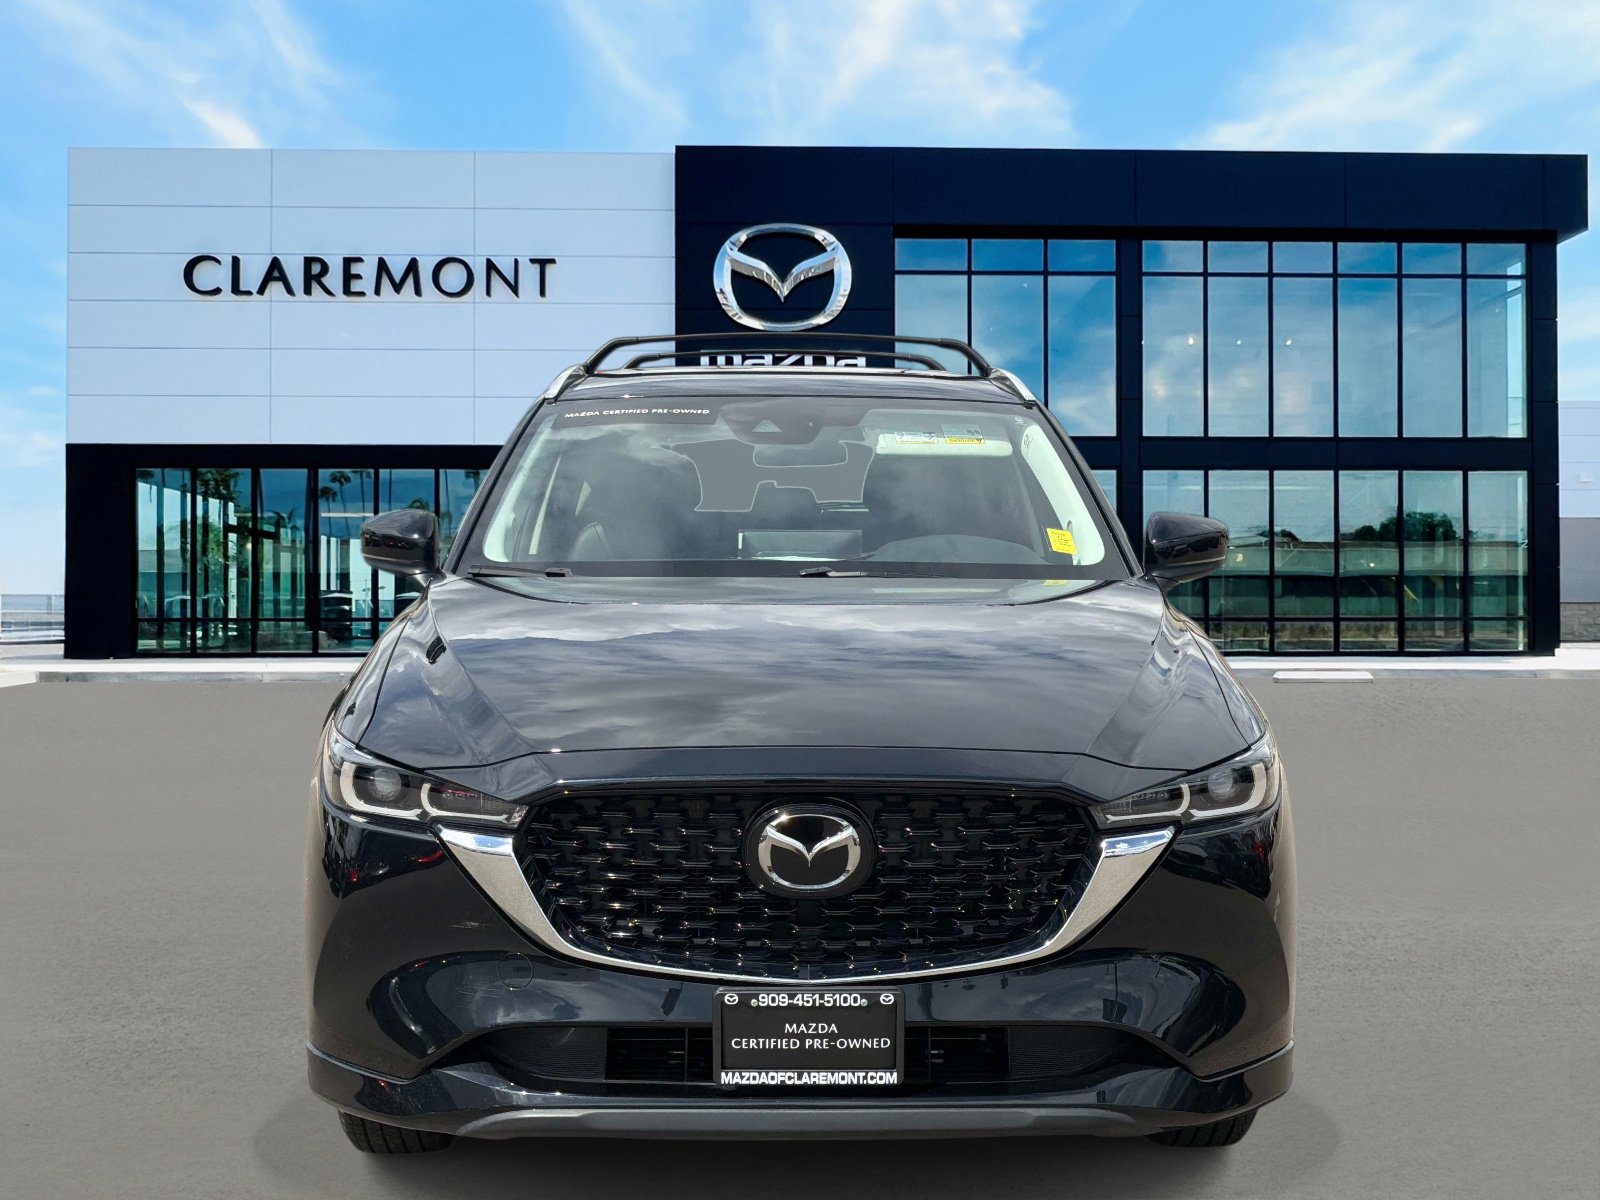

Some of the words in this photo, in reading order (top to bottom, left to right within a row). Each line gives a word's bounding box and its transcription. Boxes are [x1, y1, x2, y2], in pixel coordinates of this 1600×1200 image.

[183, 254, 557, 299] CLAREMONT
[758, 993, 861, 1007] 909-451-5100
[784, 1023, 839, 1034] MAZDA
[731, 1038, 800, 1049] CERTIFIED
[805, 1038, 891, 1049] PRE-OWNED
[720, 1072, 897, 1085] MAZDAOFCLAREMONT.COM
